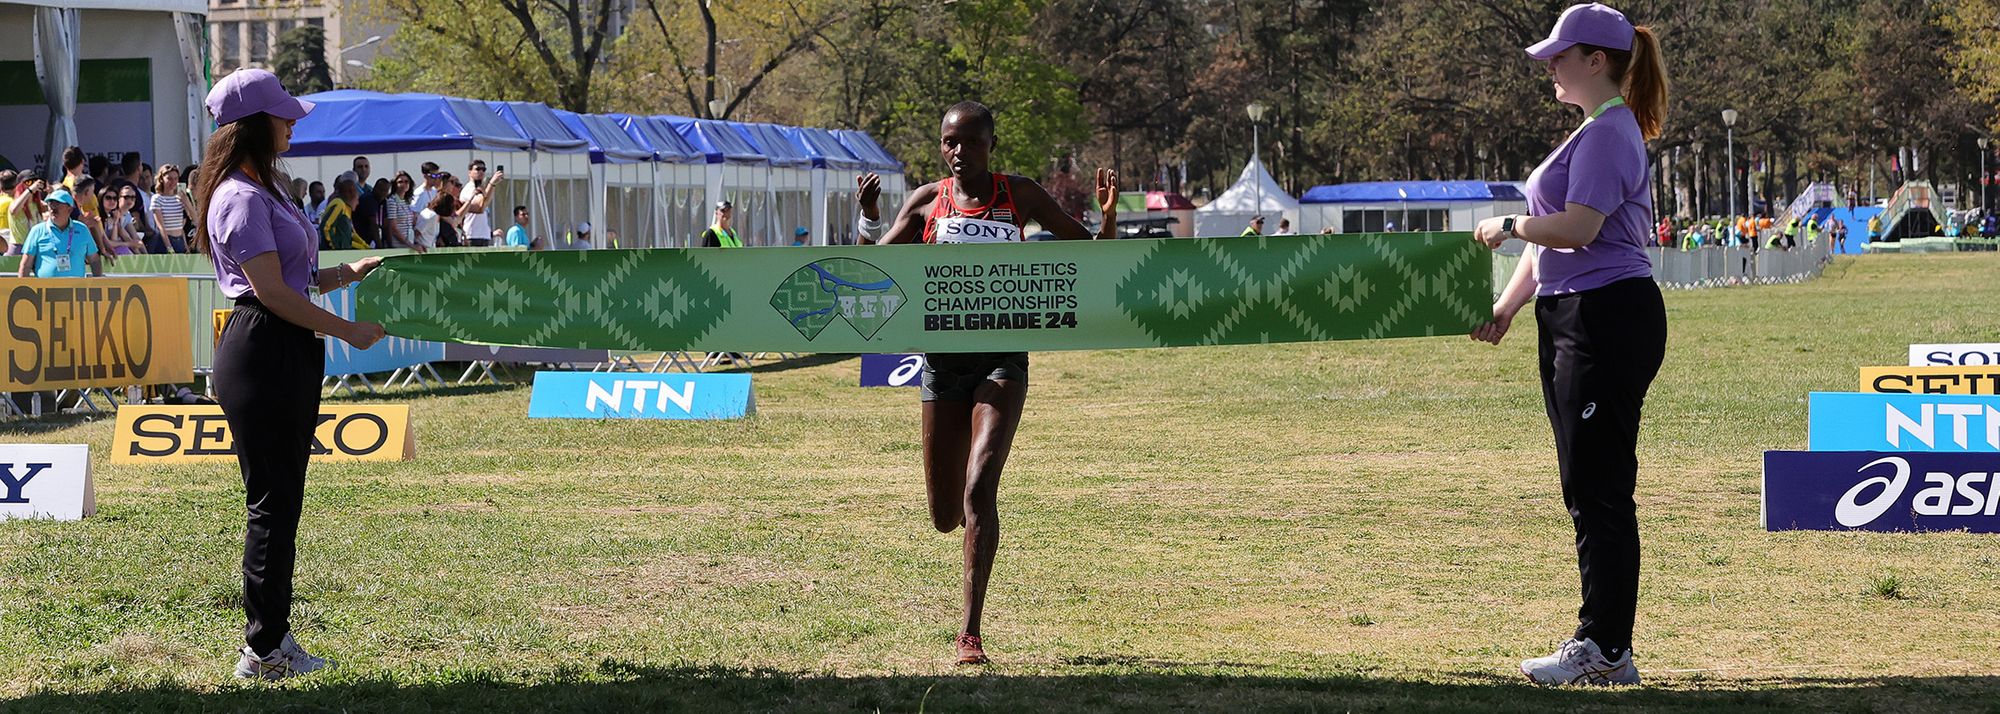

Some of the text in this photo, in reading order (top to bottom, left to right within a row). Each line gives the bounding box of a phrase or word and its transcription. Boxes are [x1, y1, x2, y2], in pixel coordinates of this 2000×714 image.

[946, 223, 1015, 240] SONY
[924, 262, 1077, 278] WORLD ATHLETICS
[924, 279, 1077, 294] CROSS COUNTRY
[924, 295, 1078, 311] CHAMPIONSHIPS
[924, 311, 1078, 331] BELGRADE 24
[7, 284, 153, 386] SEIKO
[1926, 351, 2000, 366] SO
[1872, 374, 2000, 395] SEI
[585, 379, 695, 414] NTN
[129, 412, 389, 456] SEO
[1885, 402, 2000, 450] NT
